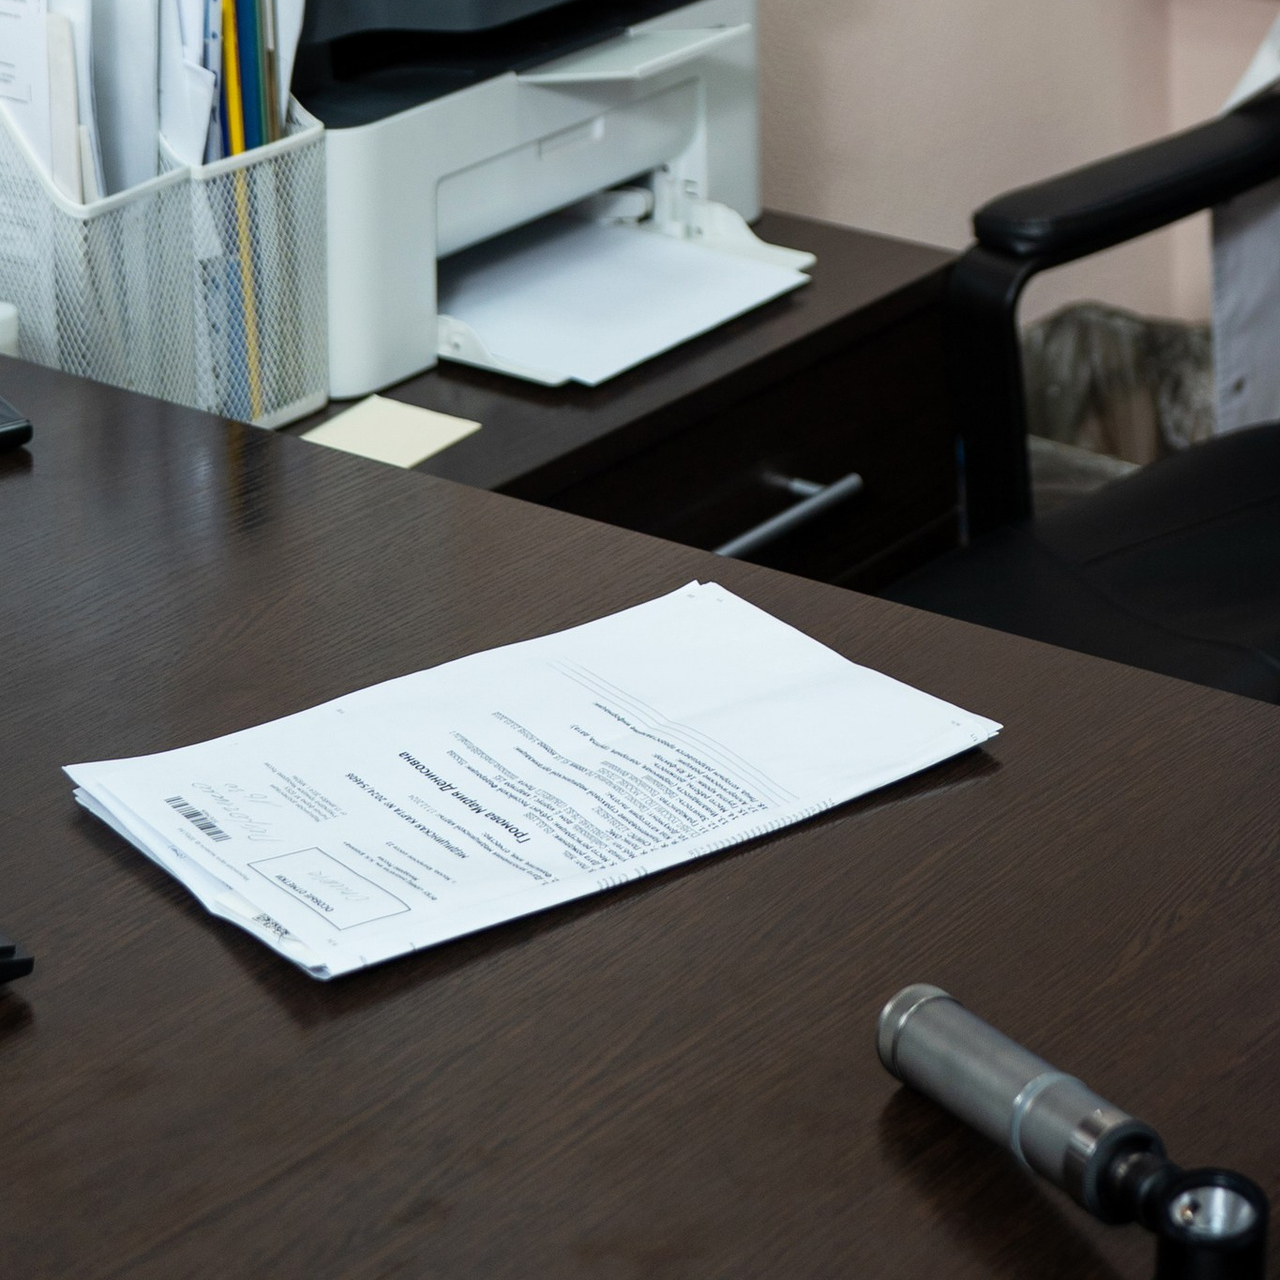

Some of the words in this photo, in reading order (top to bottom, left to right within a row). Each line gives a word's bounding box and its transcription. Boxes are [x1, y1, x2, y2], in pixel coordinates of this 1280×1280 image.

[393, 750, 459, 792] Денисовна
[446, 789, 490, 814] Мария
[391, 806, 420, 824] КАРТА
[479, 810, 534, 844] Громова
[413, 822, 470, 859] МЕДИЦИНСКАЯ
[273, 873, 309, 895] ОТМЕТКИ
[301, 892, 336, 913] ОСОБЫЕ
